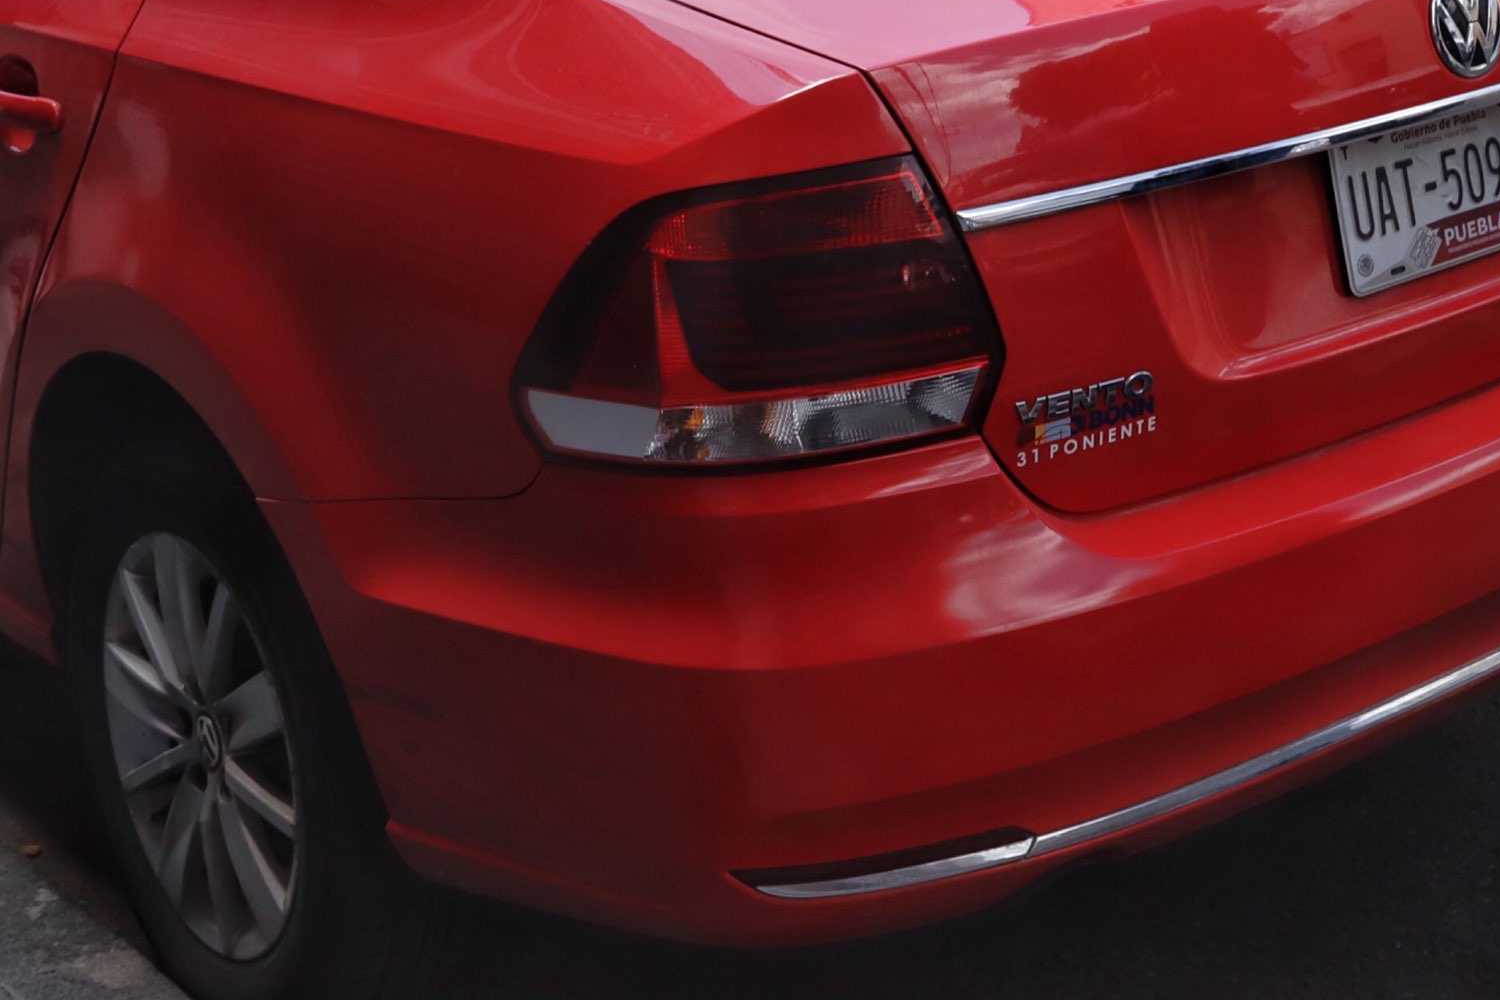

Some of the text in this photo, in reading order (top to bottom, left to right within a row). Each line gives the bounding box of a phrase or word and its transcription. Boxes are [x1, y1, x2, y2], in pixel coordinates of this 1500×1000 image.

[1390, 122, 1437, 143] Gobierno
[1439, 118, 1451, 130] de
[1453, 108, 1486, 126] Puebla
[1015, 371, 1153, 425] VENTO
[1016, 416, 1156, 468] 31 PONIENTE
